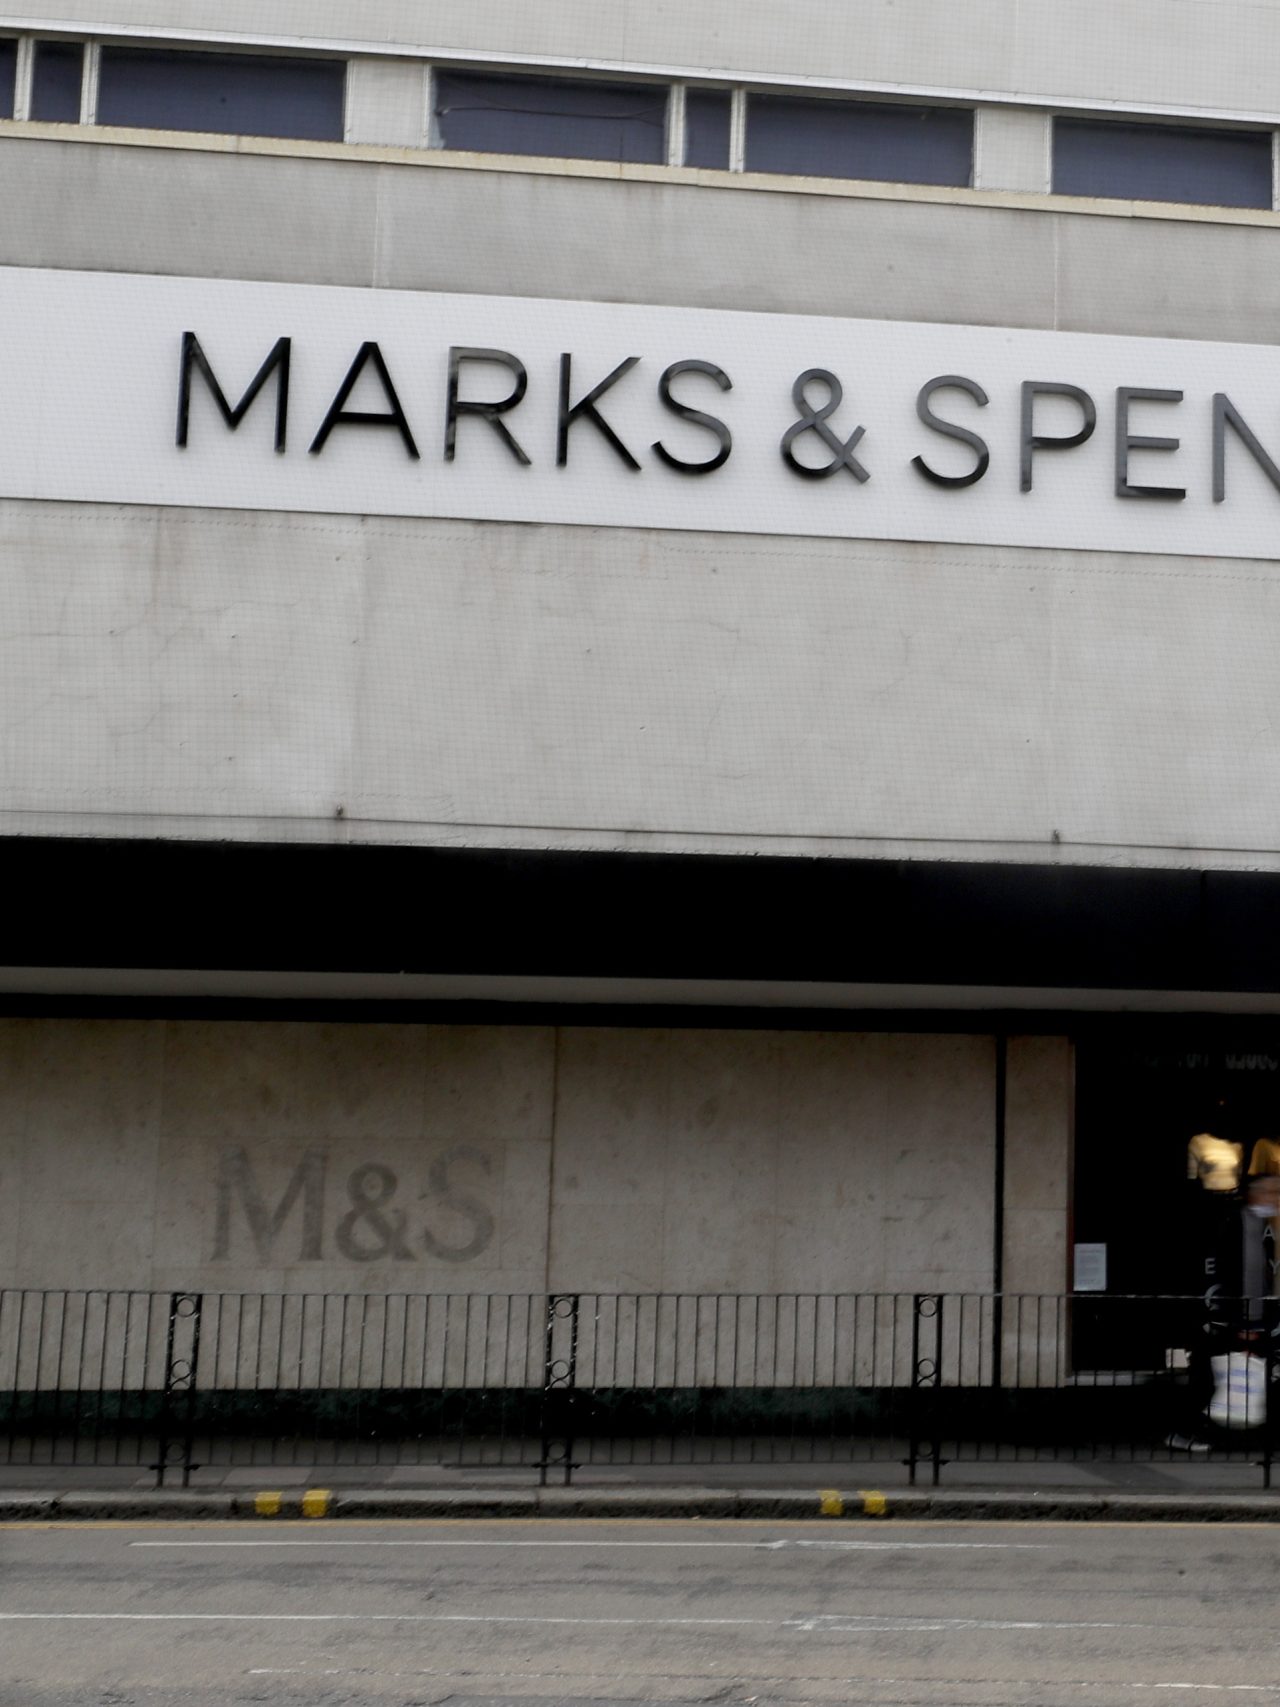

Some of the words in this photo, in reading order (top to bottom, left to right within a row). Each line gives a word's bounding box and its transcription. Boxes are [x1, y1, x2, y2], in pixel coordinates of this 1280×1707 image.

[175, 331, 733, 476] MARKS
[780, 367, 870, 484] &
[209, 1144, 495, 1264] M&S
